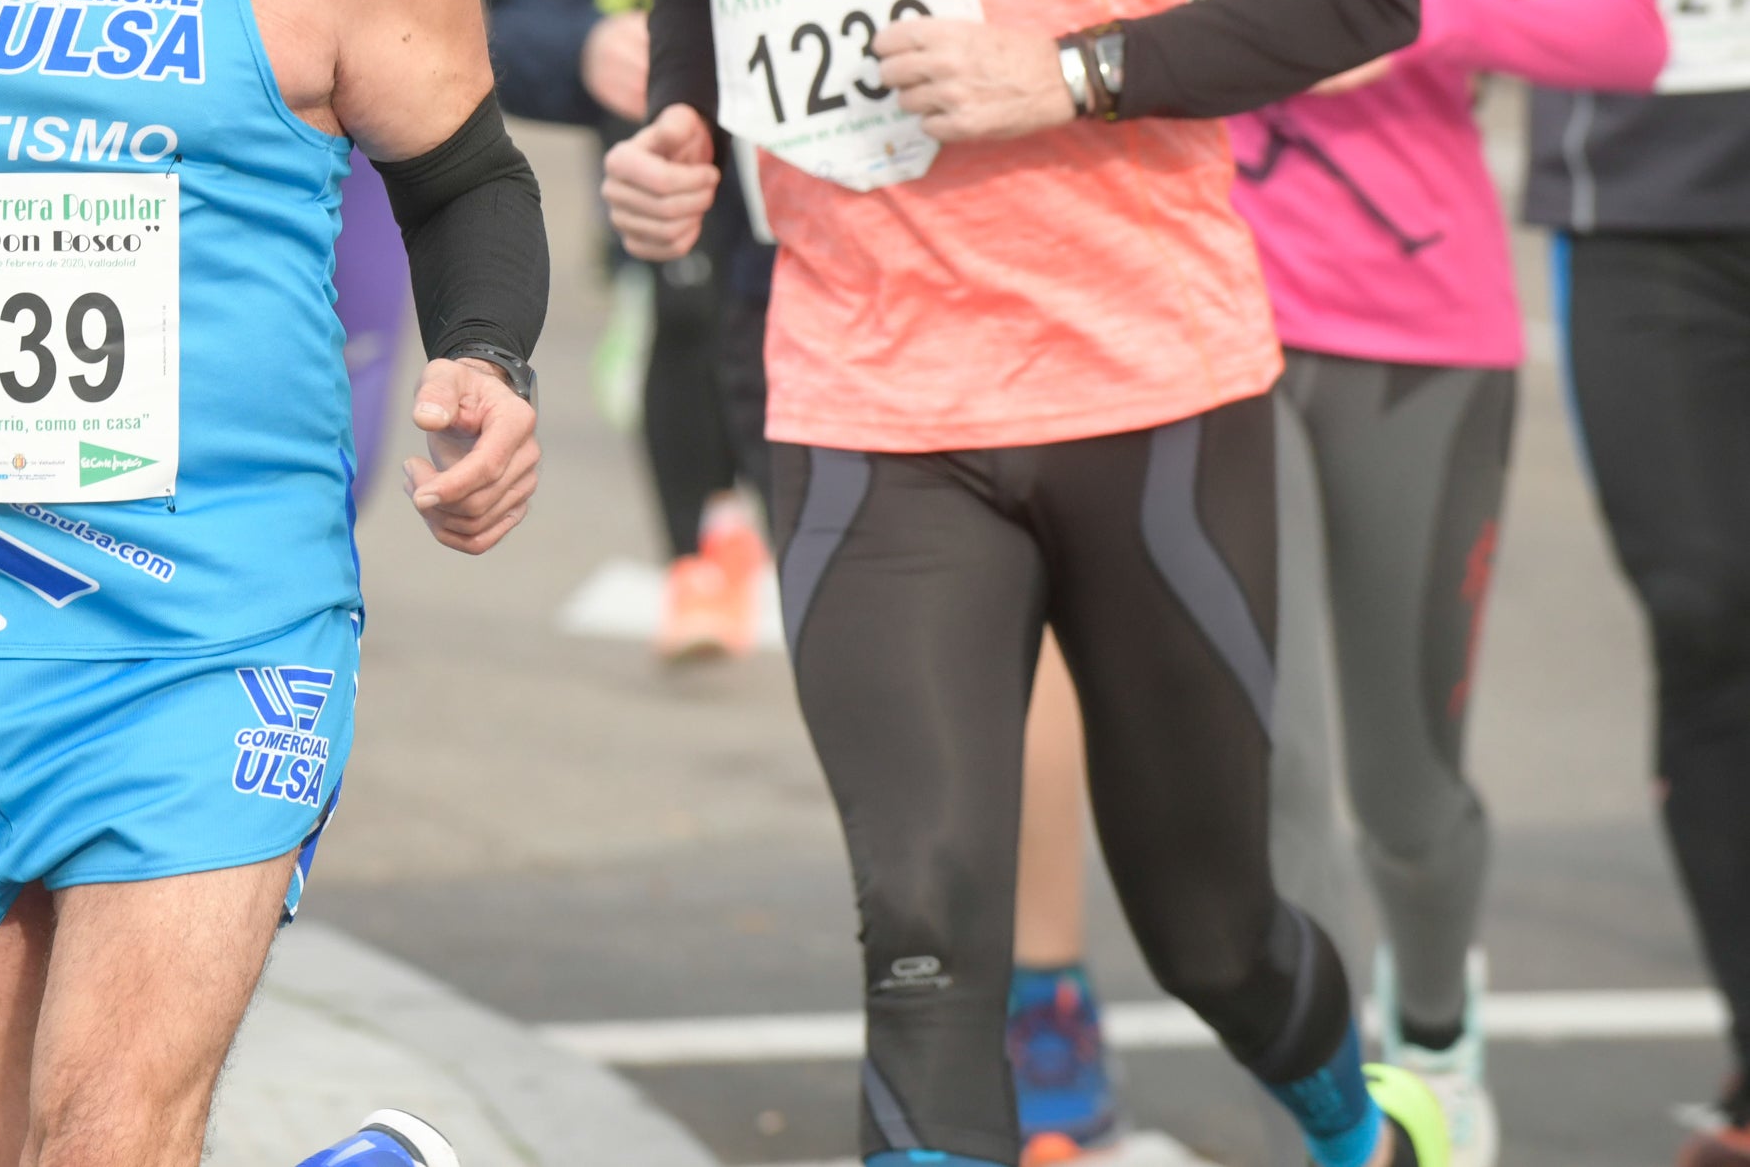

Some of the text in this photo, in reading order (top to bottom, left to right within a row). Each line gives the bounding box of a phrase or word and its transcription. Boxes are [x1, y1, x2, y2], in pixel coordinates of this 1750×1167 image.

[63, 193, 166, 226] Popular
[5, 258, 43, 267] febrero
[46, 258, 58, 267] de
[61, 258, 86, 269] 2020,
[35, 417, 76, 431] como
[83, 417, 100, 430] en
[237, 730, 329, 758] COMERCIAL
[235, 750, 324, 806] ULSA
